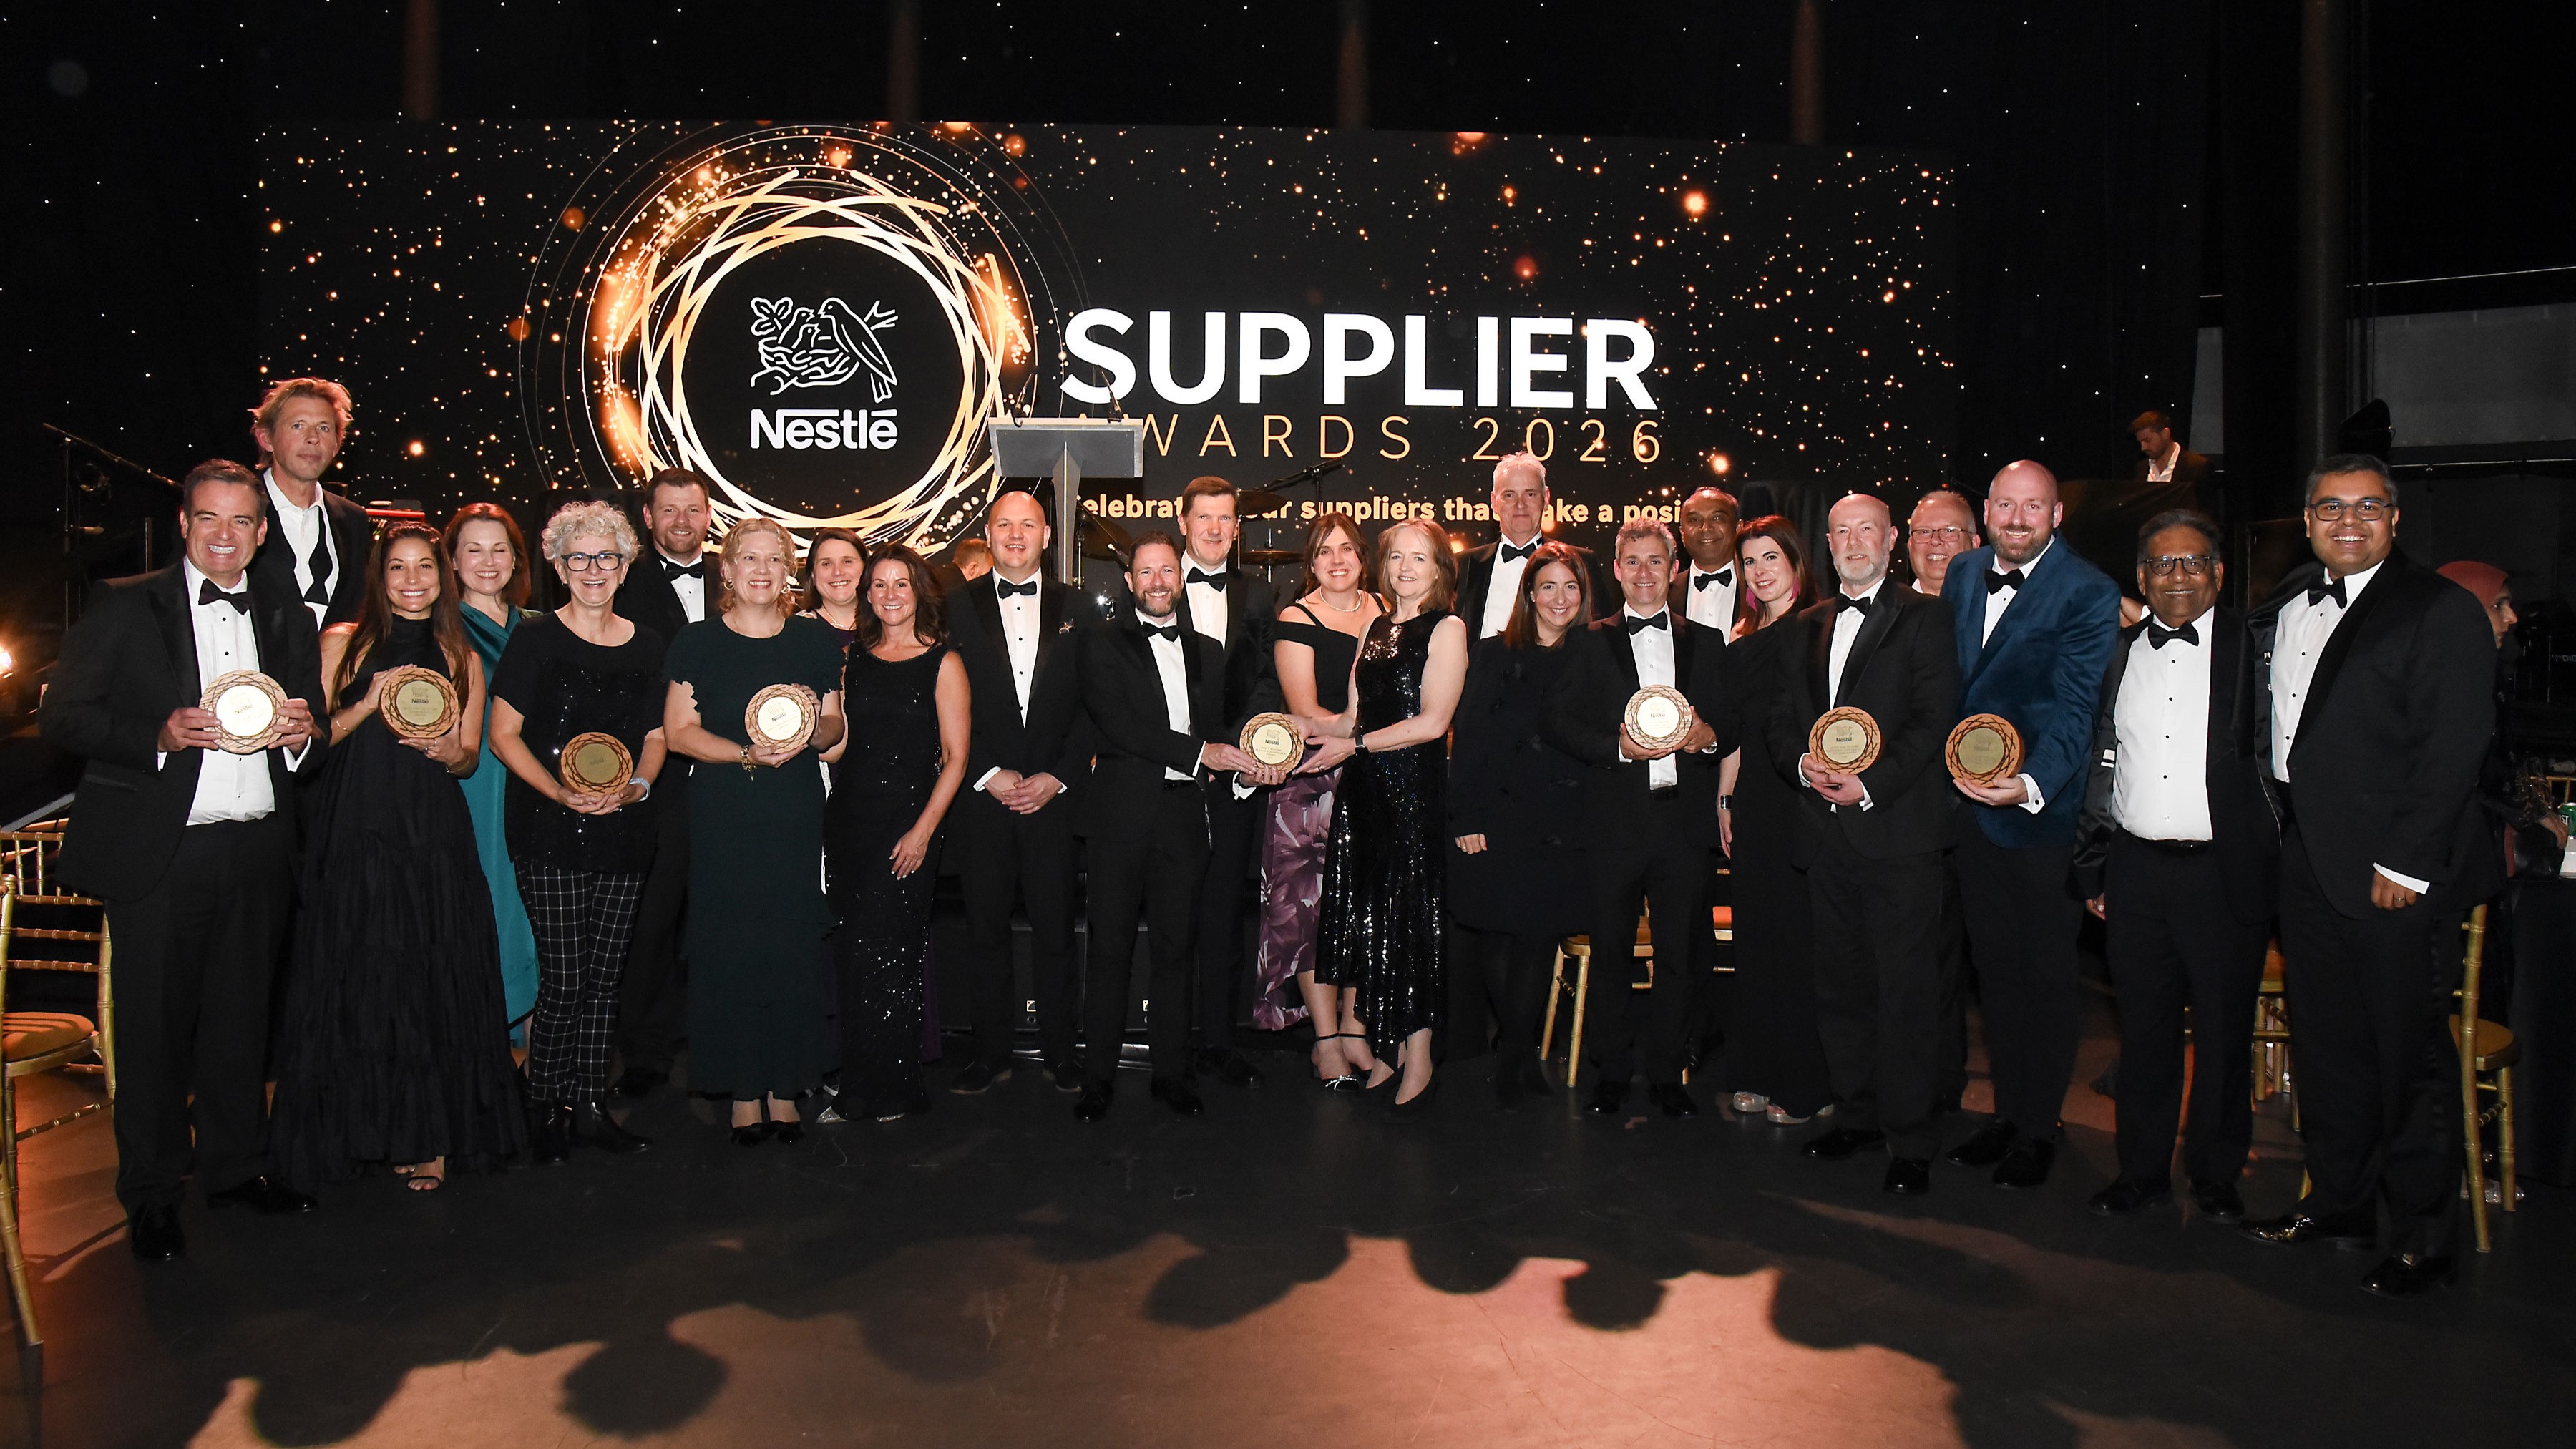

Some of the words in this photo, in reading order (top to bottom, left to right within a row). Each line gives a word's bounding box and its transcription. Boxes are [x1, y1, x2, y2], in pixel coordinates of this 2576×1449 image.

[1060, 308, 1659, 410] SUPPLIER
[751, 409, 898, 449] Nestlé
[1079, 414, 1410, 459] WARDS
[1473, 417, 1660, 463] 2026
[1541, 498, 1589, 522] ake
[1597, 504, 1613, 523] a
[1624, 499, 1682, 524] posi
